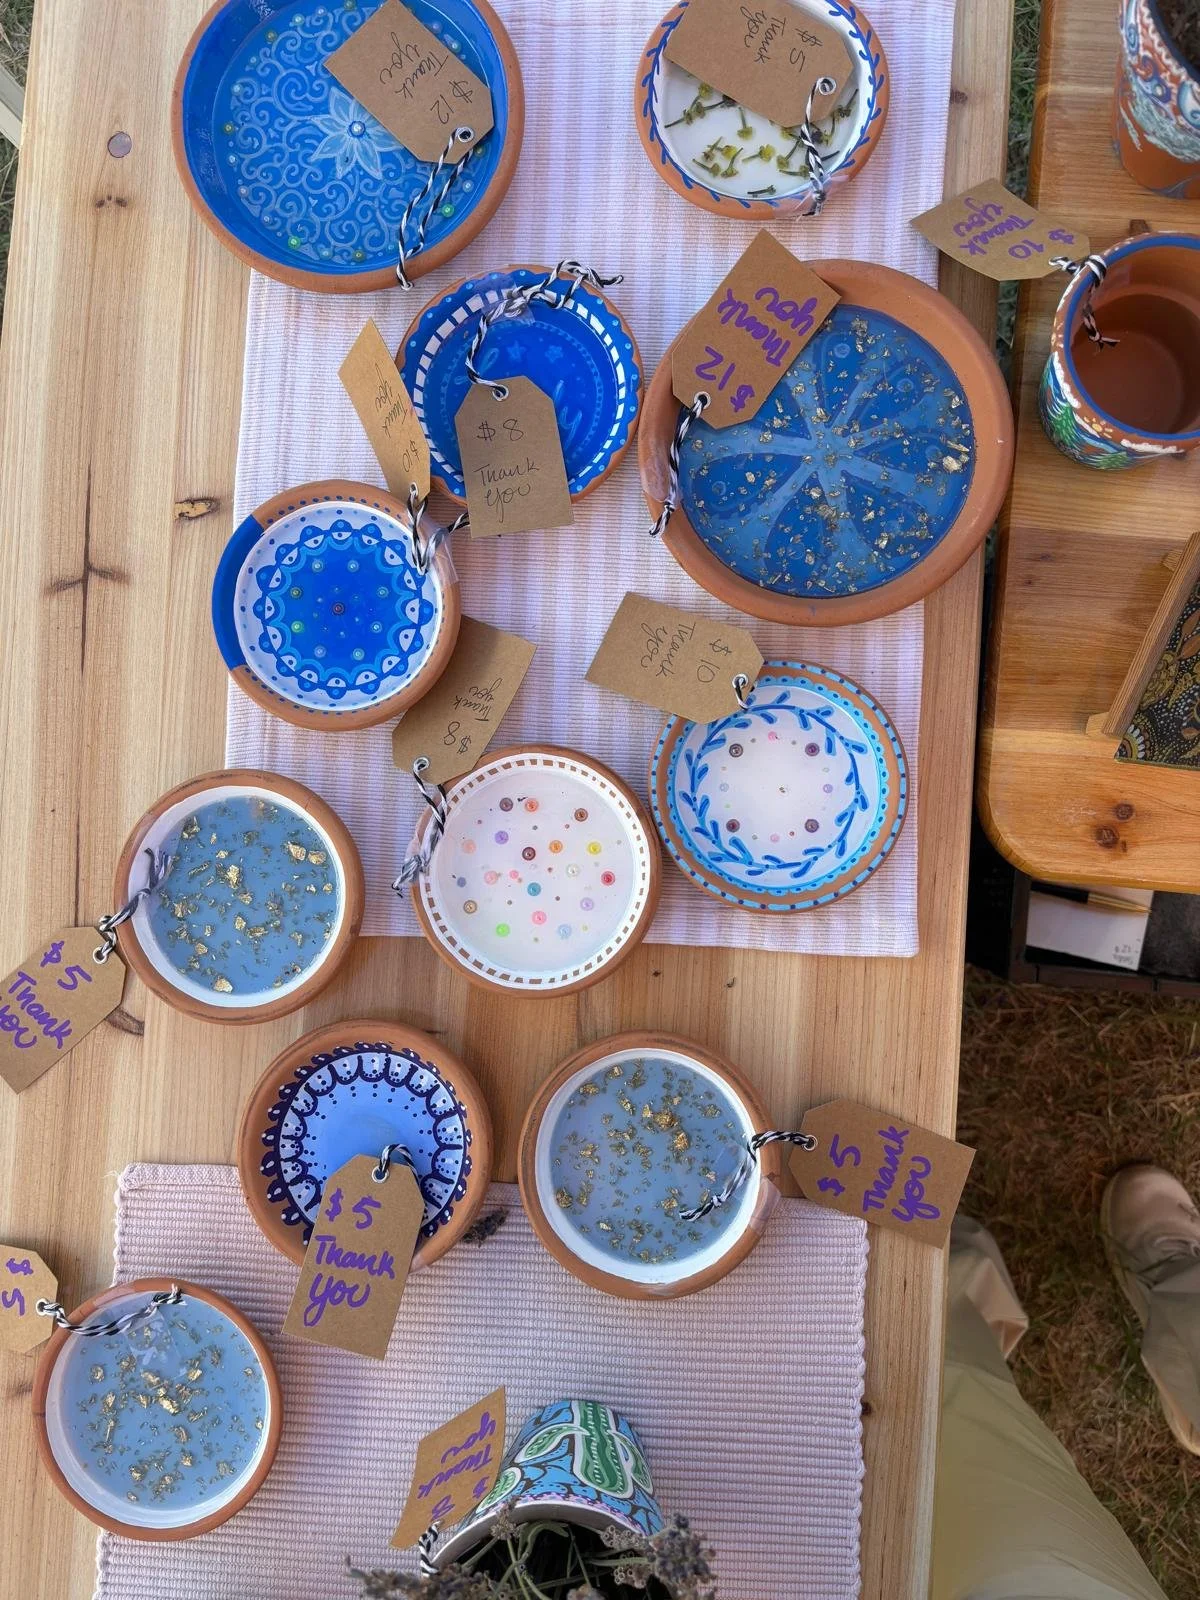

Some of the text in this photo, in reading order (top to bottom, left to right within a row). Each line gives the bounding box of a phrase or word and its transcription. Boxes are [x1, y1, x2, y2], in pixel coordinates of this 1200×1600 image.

[754, 17, 787, 64] Thank
[395, 51, 449, 99] Thank
[960, 214, 1034, 256] Thank
[717, 288, 791, 367] Thank
[382, 393, 408, 438] Thank
[473, 457, 540, 487] Thank
[655, 621, 697, 677] Thank
[452, 695, 492, 722] Thank
[8, 971, 73, 1049] Thank
[863, 1125, 910, 1213] Thank
[315, 1234, 396, 1280] Thank
[417, 1443, 493, 1499] Thank
